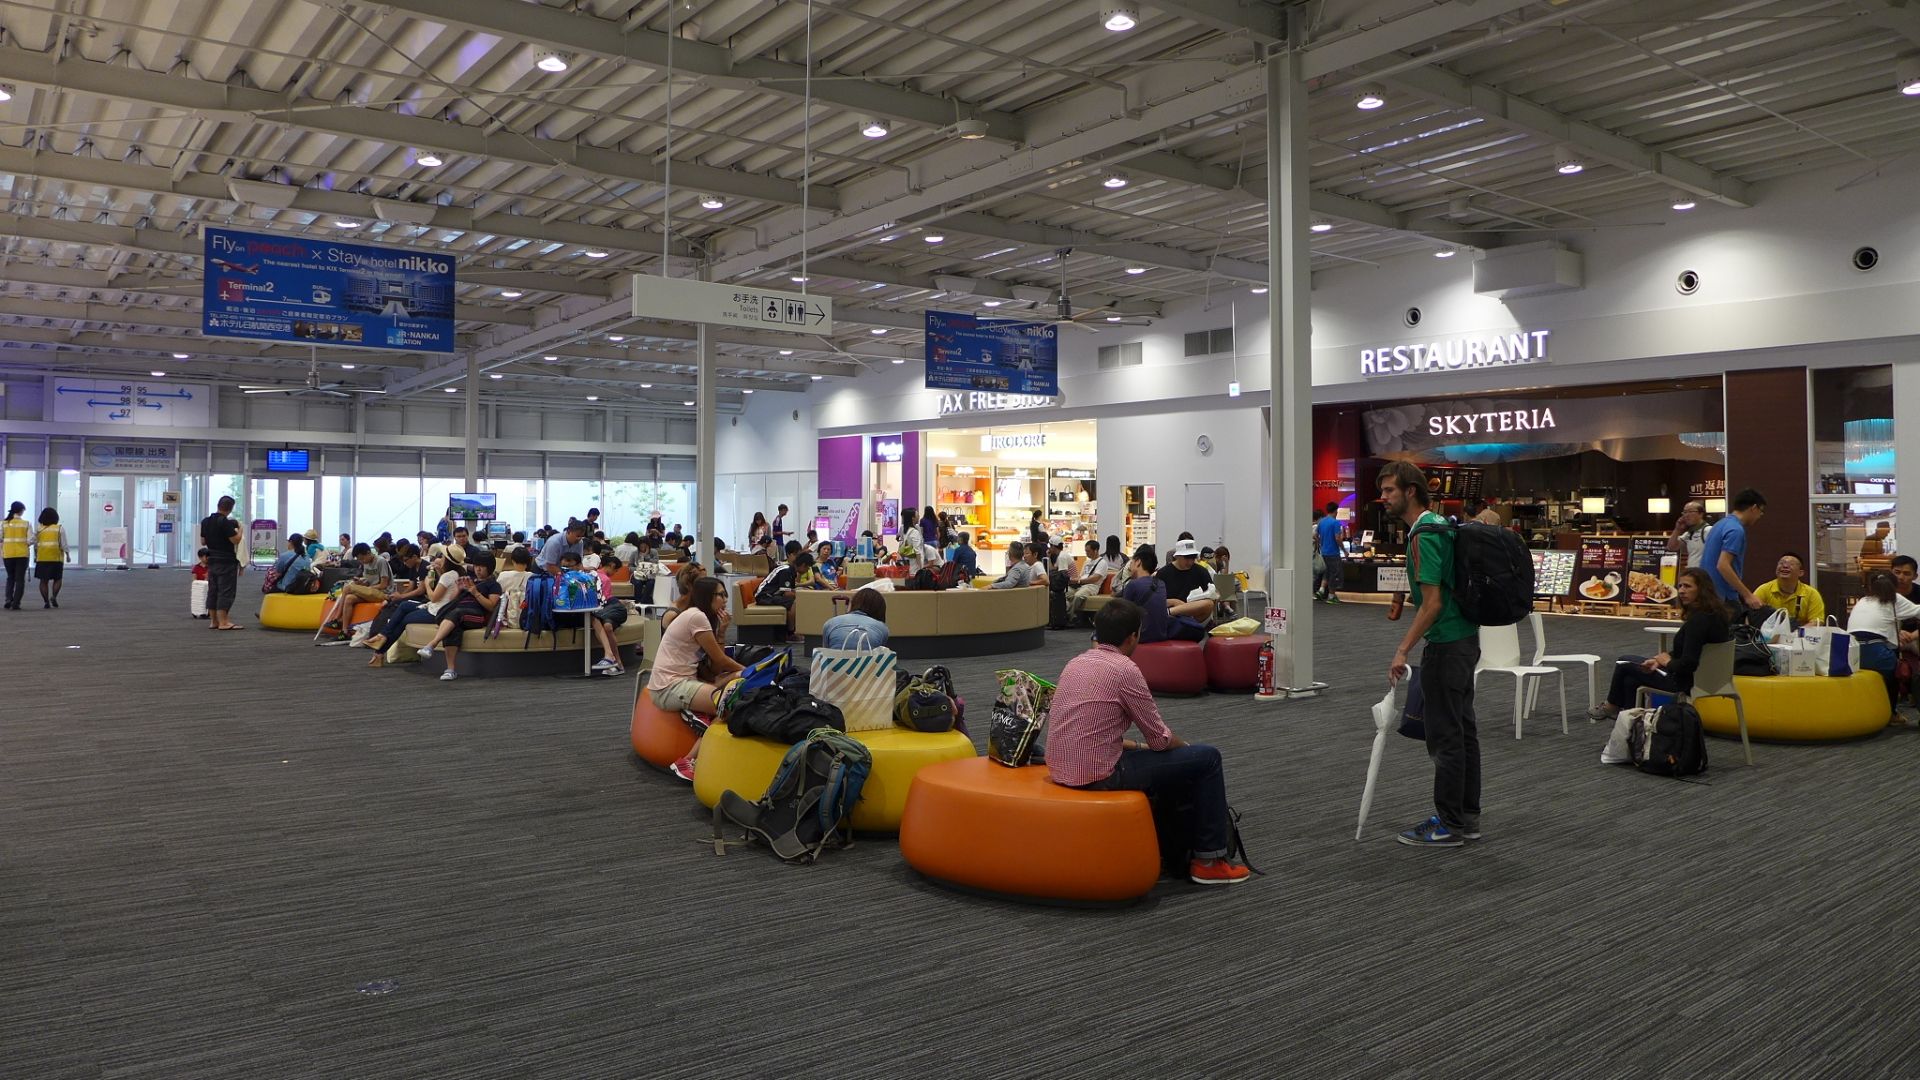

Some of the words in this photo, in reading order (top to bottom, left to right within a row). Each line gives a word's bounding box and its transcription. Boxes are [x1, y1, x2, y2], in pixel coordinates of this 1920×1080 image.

[212, 234, 236, 254] Fly
[328, 248, 362, 267] Stay
[371, 257, 397, 268] hotel
[399, 256, 449, 274] nikko
[227, 281, 274, 293] Terminal2
[1027, 326, 1054, 339] nikko
[1361, 330, 1549, 374] RESTAURANT
[120, 385, 132, 394] 99
[137, 386, 147, 394] 95
[936, 393, 963, 413] TAX
[969, 391, 1005, 410] FREE
[120, 409, 131, 417] 97
[1429, 407, 1556, 435] SKYTERIA
[840, 504, 860, 539] peach
